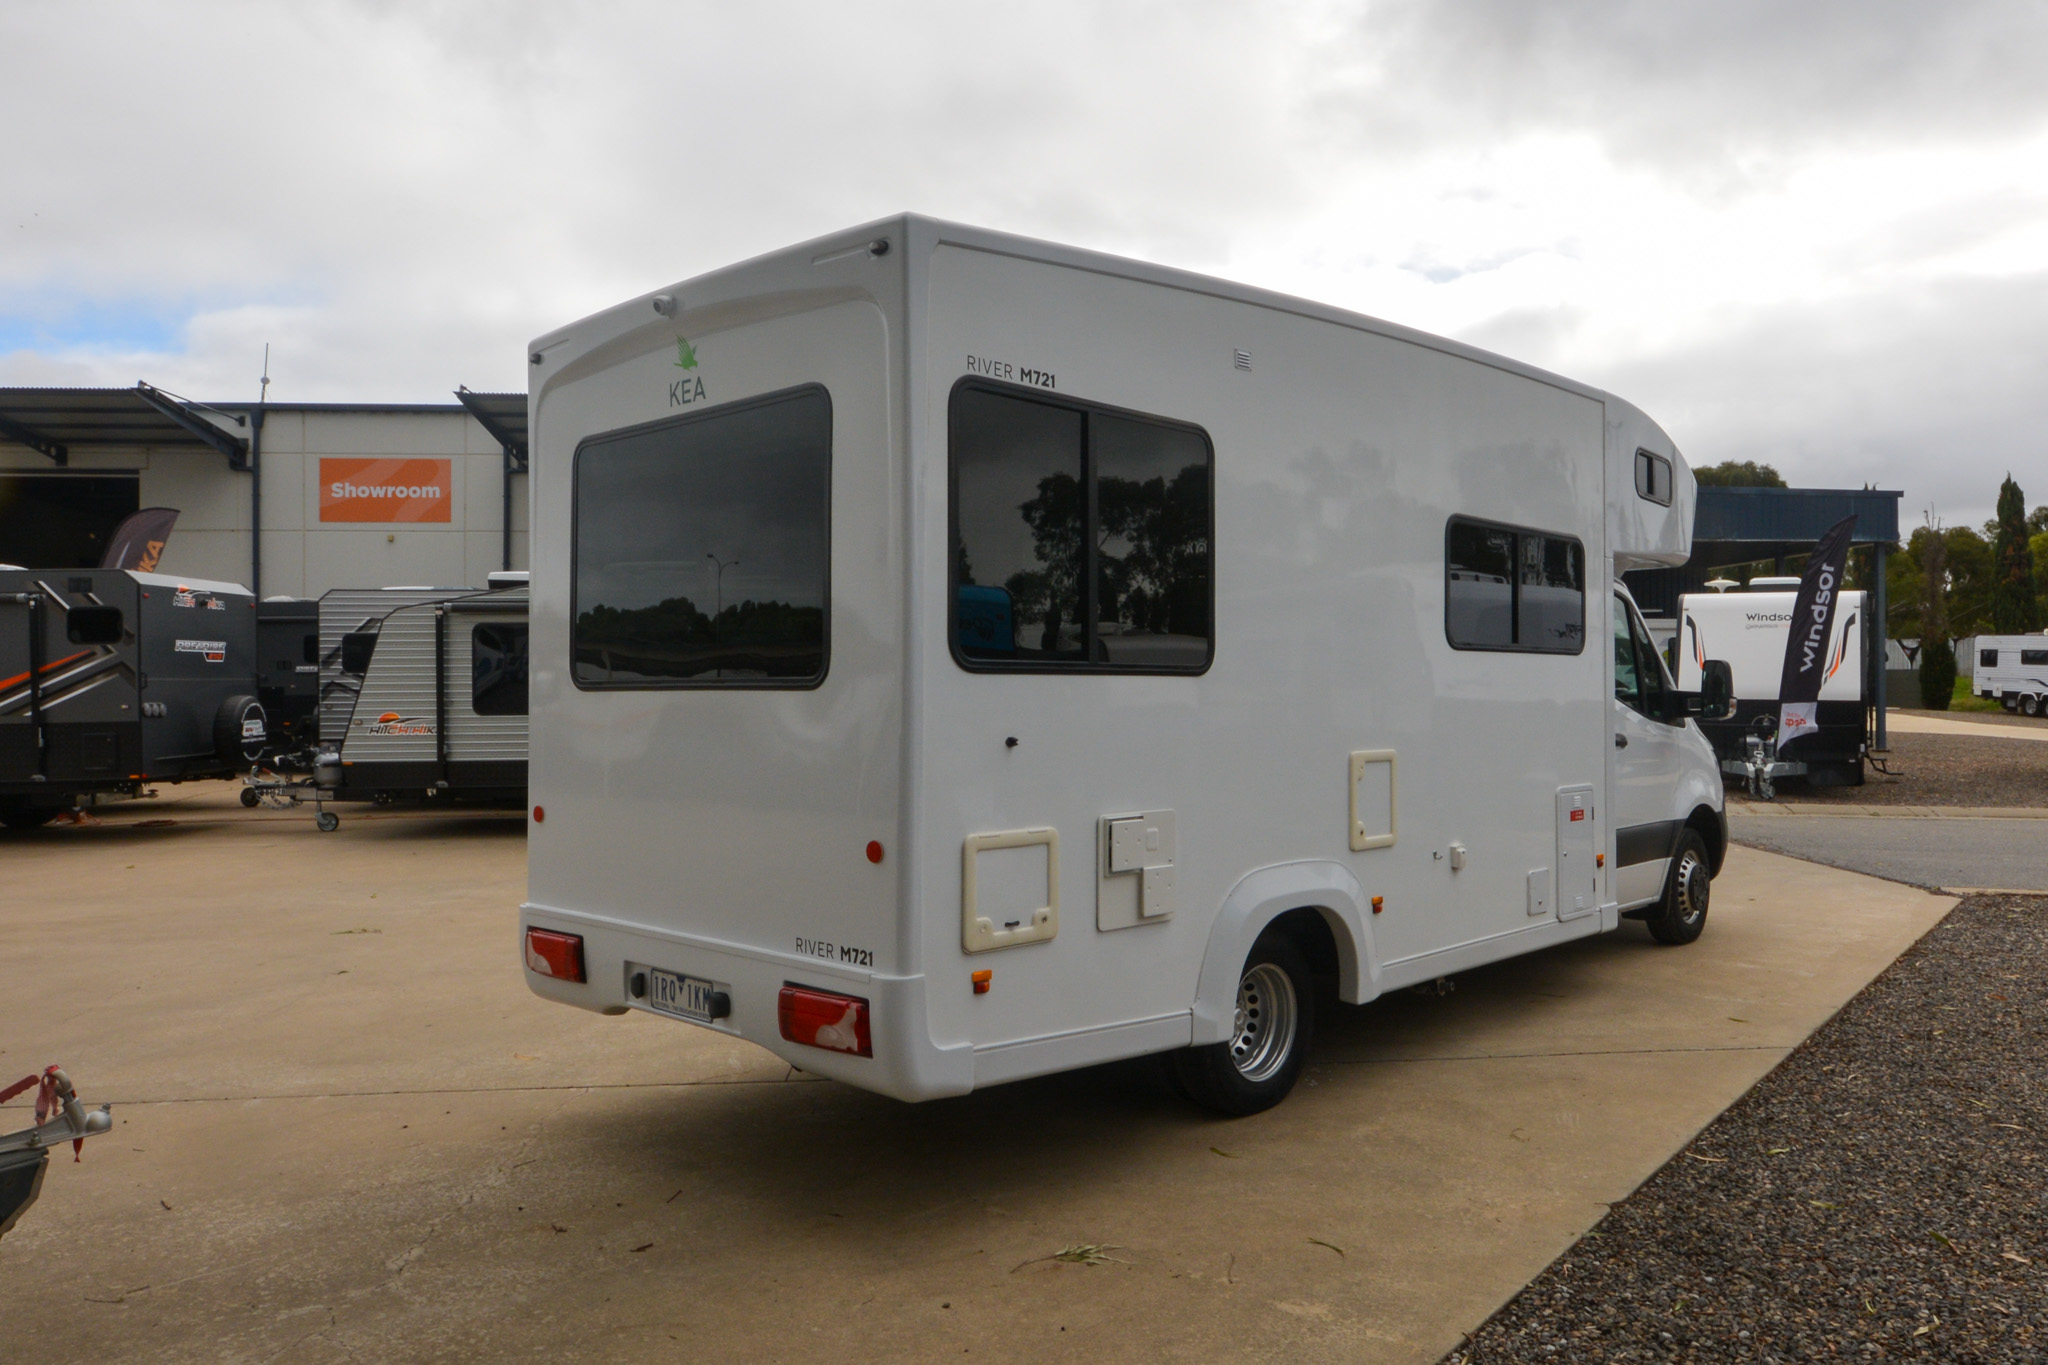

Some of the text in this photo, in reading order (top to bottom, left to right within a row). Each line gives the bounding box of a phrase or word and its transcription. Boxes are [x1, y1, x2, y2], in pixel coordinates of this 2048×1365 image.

[967, 355, 1056, 389] RIVER M721
[669, 376, 707, 408] KEA
[331, 482, 441, 499] Showroom
[1746, 613, 1792, 621] Windso
[1800, 562, 1835, 673] windsor
[412, 725, 437, 735] HIK
[796, 937, 873, 968] RIVER M721
[655, 976, 711, 1012] 1RQ 1KM
